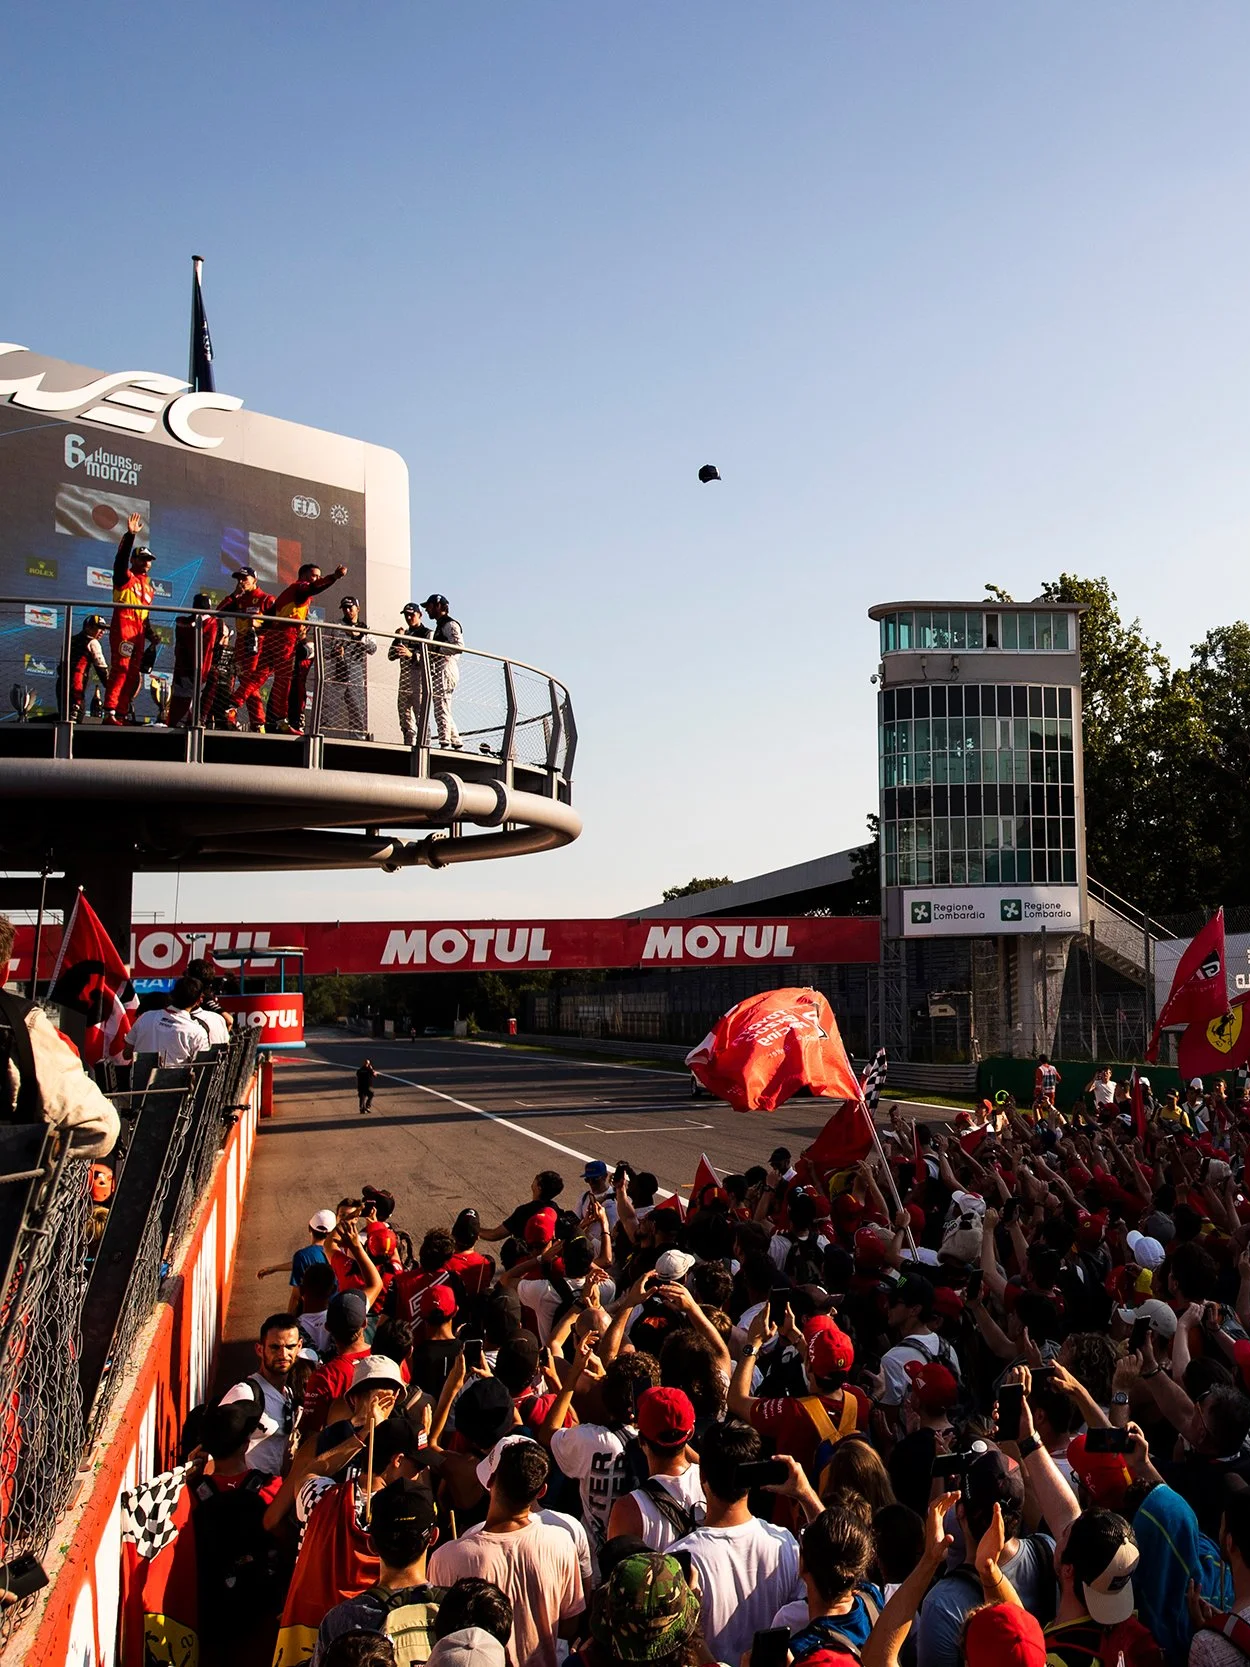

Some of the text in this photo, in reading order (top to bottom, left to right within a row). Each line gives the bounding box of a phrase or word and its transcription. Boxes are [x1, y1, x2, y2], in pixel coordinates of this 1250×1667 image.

[64, 433, 143, 473] 6 HOURS OF
[86, 462, 139, 486] MONZA
[292, 500, 319, 516] FIA
[29, 567, 55, 577] ROLEX
[933, 903, 974, 914] Regione
[1024, 901, 1062, 912] Regione
[1024, 909, 1072, 919] Lombardia
[933, 911, 985, 920] Lombardia
[380, 927, 552, 965] MOTUL
[641, 924, 795, 960] MOTUL
[131, 931, 277, 970] OTUL
